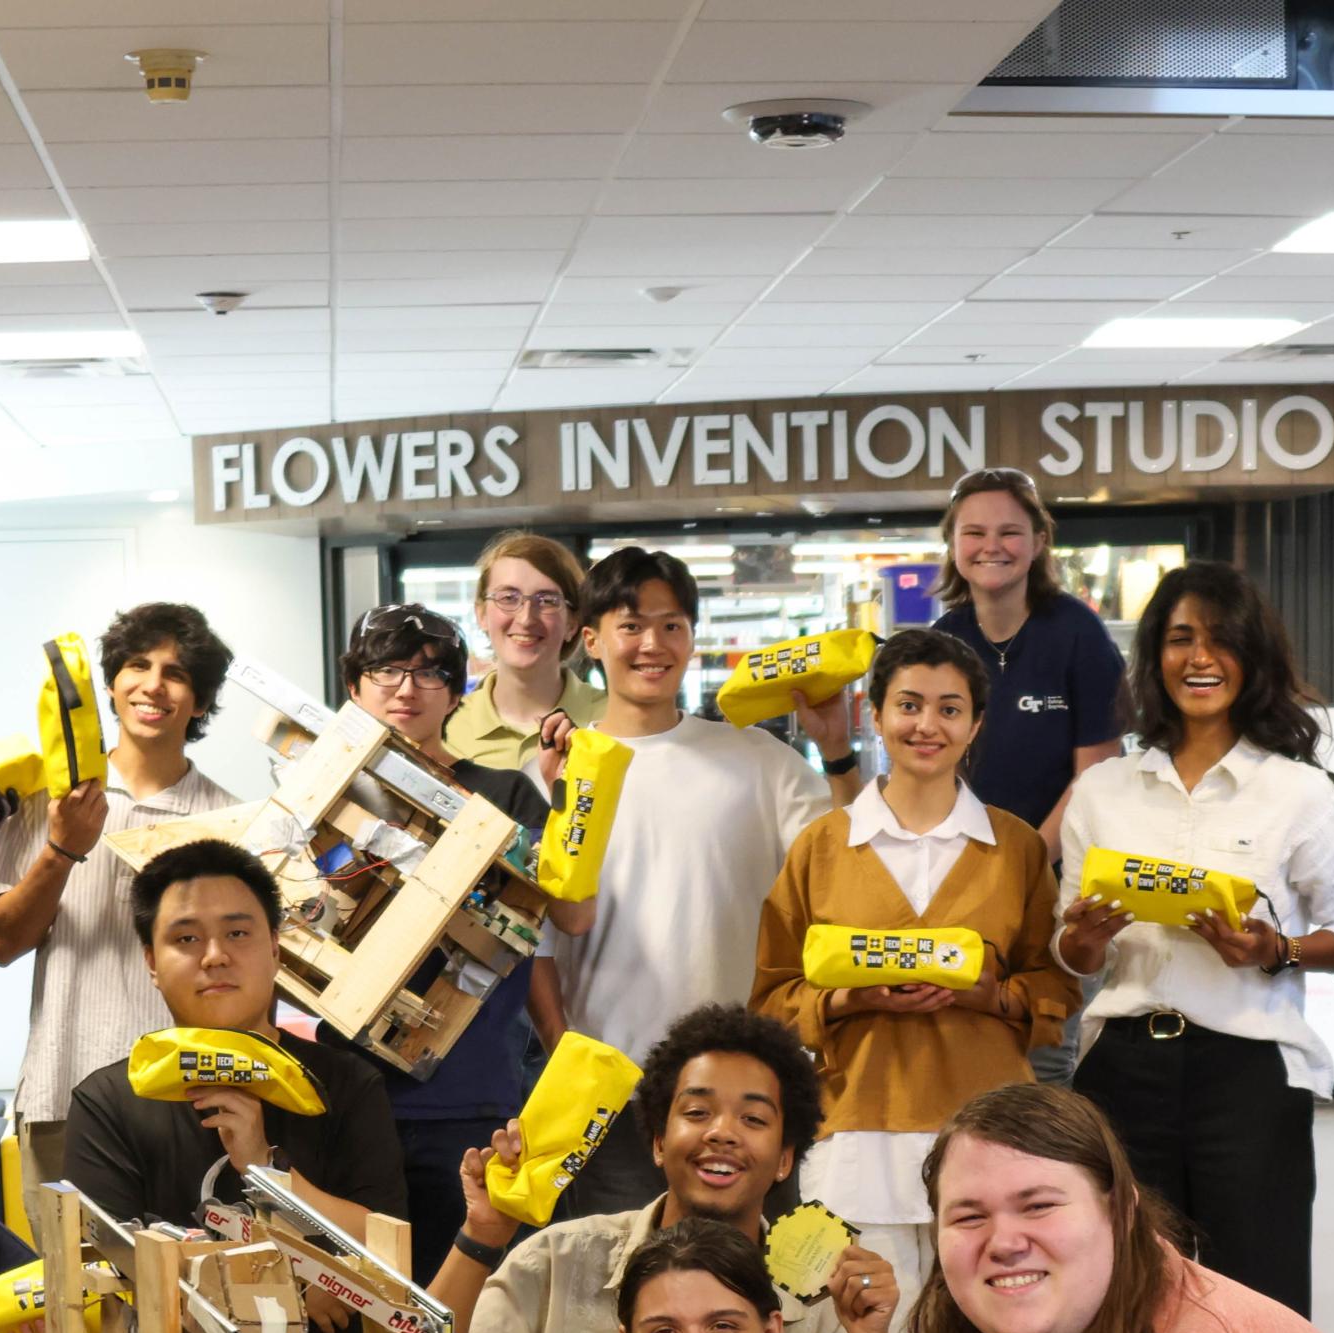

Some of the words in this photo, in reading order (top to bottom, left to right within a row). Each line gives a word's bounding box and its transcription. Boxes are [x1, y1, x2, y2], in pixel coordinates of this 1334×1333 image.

[212, 424, 520, 511] FLOWERS
[560, 403, 986, 493] INVENTION
[1018, 695, 1043, 712] GT
[919, 940, 932, 952] ME
[317, 1272, 373, 1309] aigner
